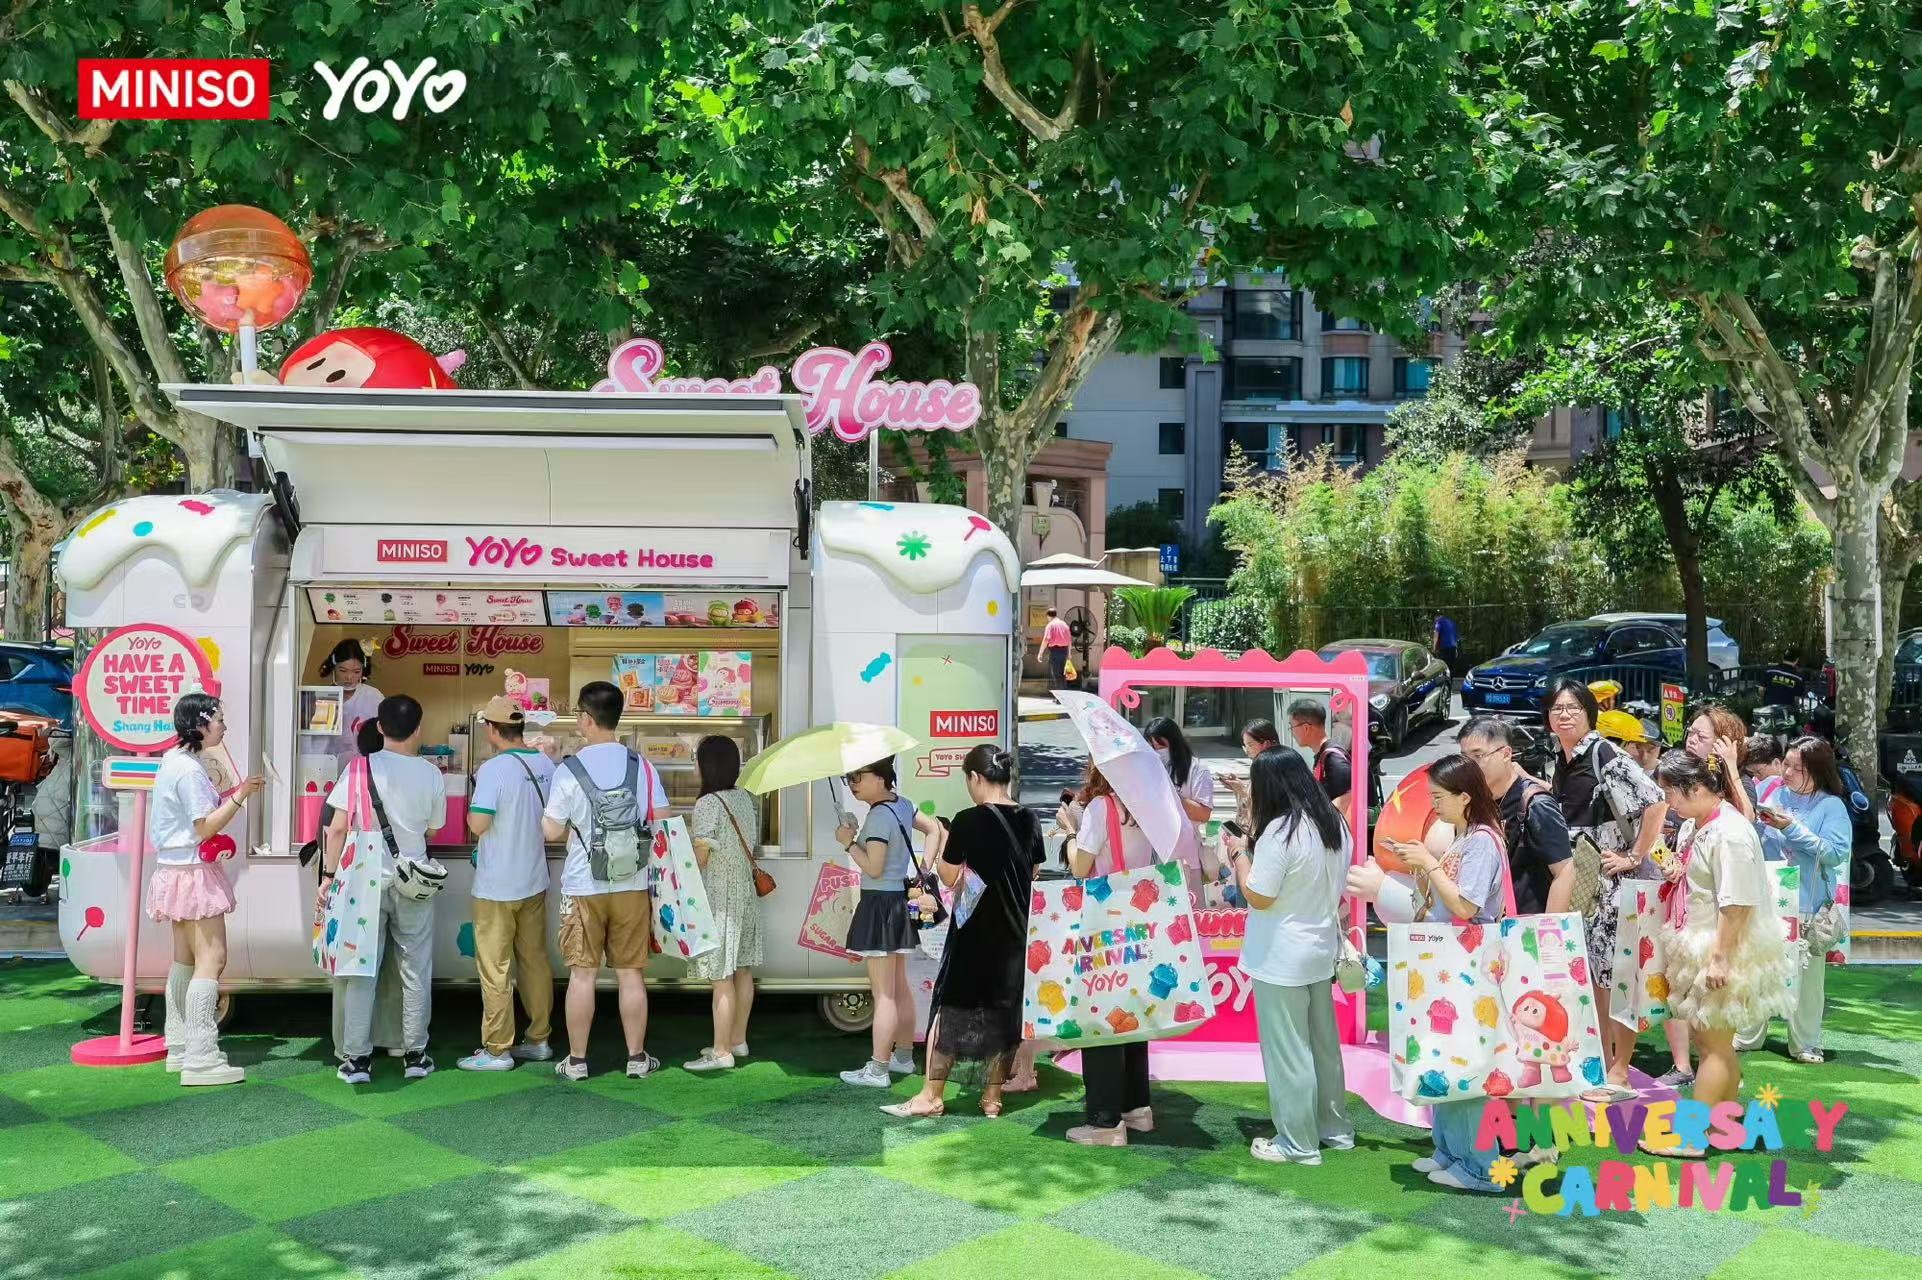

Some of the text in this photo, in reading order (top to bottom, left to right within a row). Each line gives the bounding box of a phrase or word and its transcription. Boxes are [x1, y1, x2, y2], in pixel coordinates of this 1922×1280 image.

[381, 543, 443, 559] MINISO
[551, 547, 630, 569] Sweet
[637, 548, 715, 569] House
[383, 625, 545, 660] Sweet House
[103, 653, 186, 674] HAVE A
[425, 665, 458, 674] MINISO
[103, 675, 184, 695] SWEET
[116, 696, 171, 715] TIME
[113, 719, 152, 733] Shang
[935, 714, 995, 733] MINISO
[820, 873, 860, 893] PUSH
